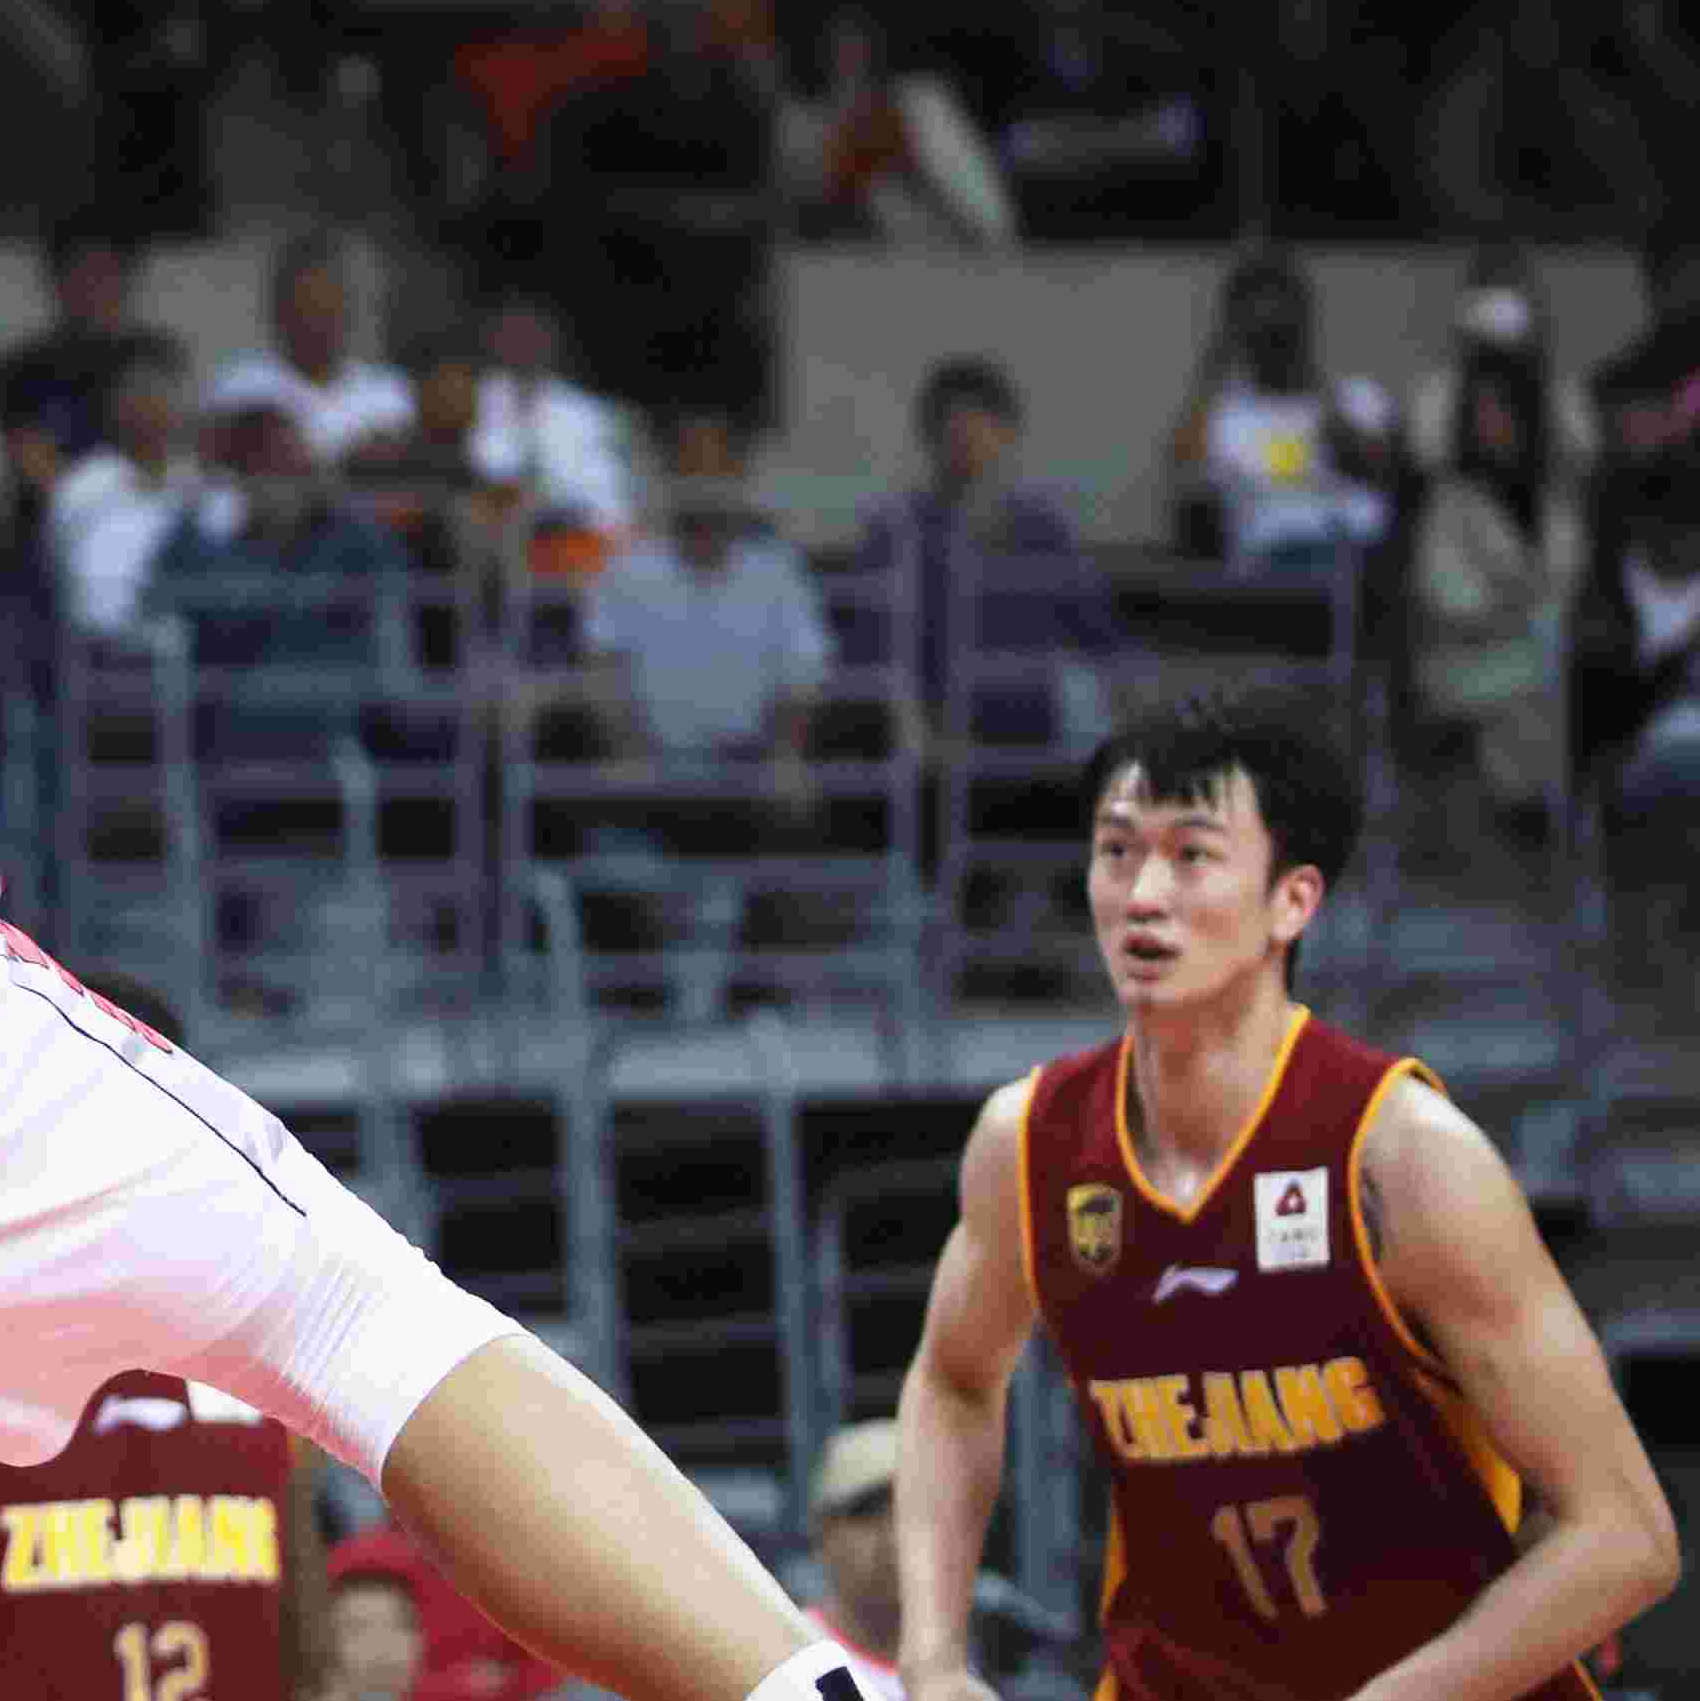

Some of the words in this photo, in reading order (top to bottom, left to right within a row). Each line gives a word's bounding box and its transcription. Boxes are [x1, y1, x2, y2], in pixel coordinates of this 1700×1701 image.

[1088, 1354, 1386, 1464] ZHEJIANG
[1210, 1494, 1329, 1621] 17
[113, 1619, 211, 1701] 12
